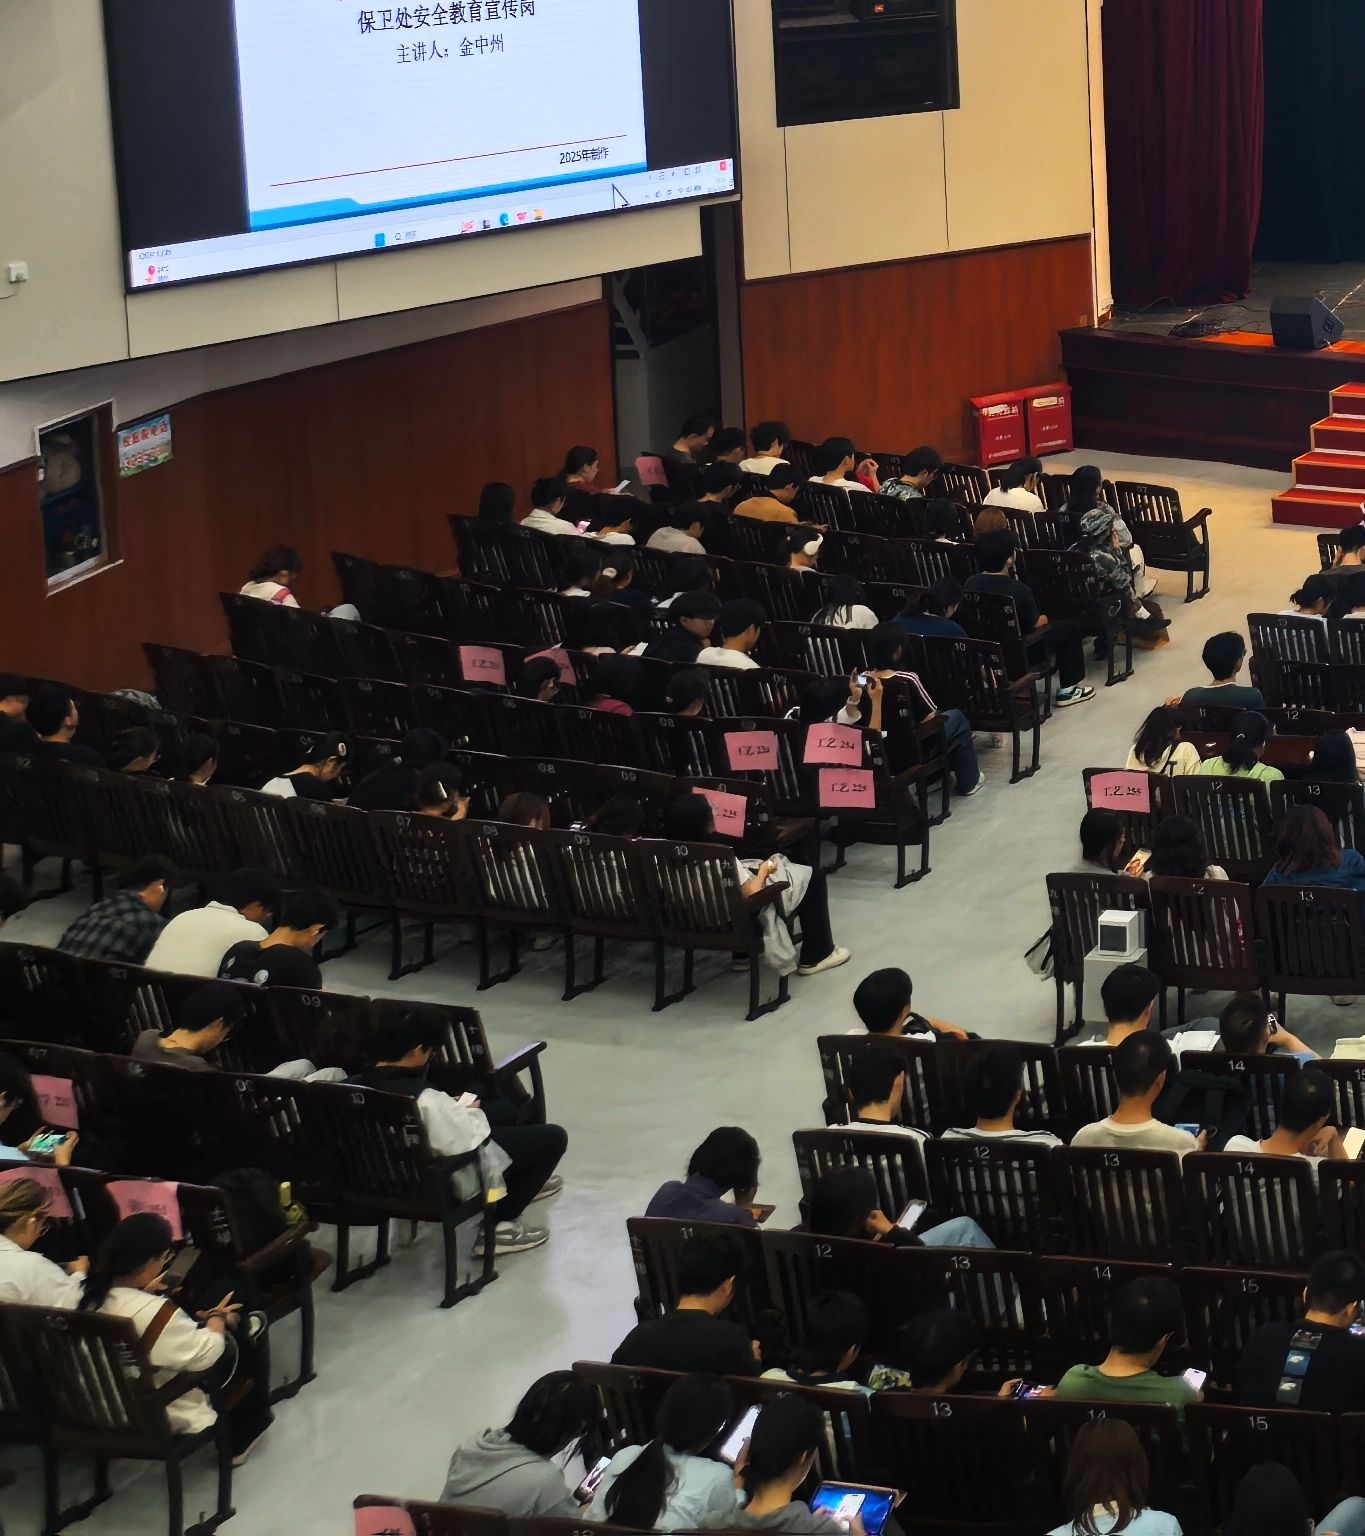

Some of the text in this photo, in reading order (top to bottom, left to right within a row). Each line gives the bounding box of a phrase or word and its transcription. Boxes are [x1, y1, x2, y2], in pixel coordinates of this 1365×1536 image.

[1285, 707, 1299, 720] 12
[1307, 784, 1321, 796] 13
[673, 845, 689, 857] 10
[1299, 889, 1315, 902] 13
[1227, 1059, 1246, 1071] 14
[973, 1145, 992, 1160] 12
[1103, 1153, 1120, 1168] 13
[1236, 1161, 1255, 1175] 14
[680, 1226, 694, 1240] 11
[815, 1243, 833, 1258] 12
[951, 1255, 972, 1270] 13
[1095, 1264, 1112, 1280] 14
[1241, 1277, 1260, 1293] 15
[932, 1401, 953, 1417] 13
[1248, 1415, 1269, 1431] 15
